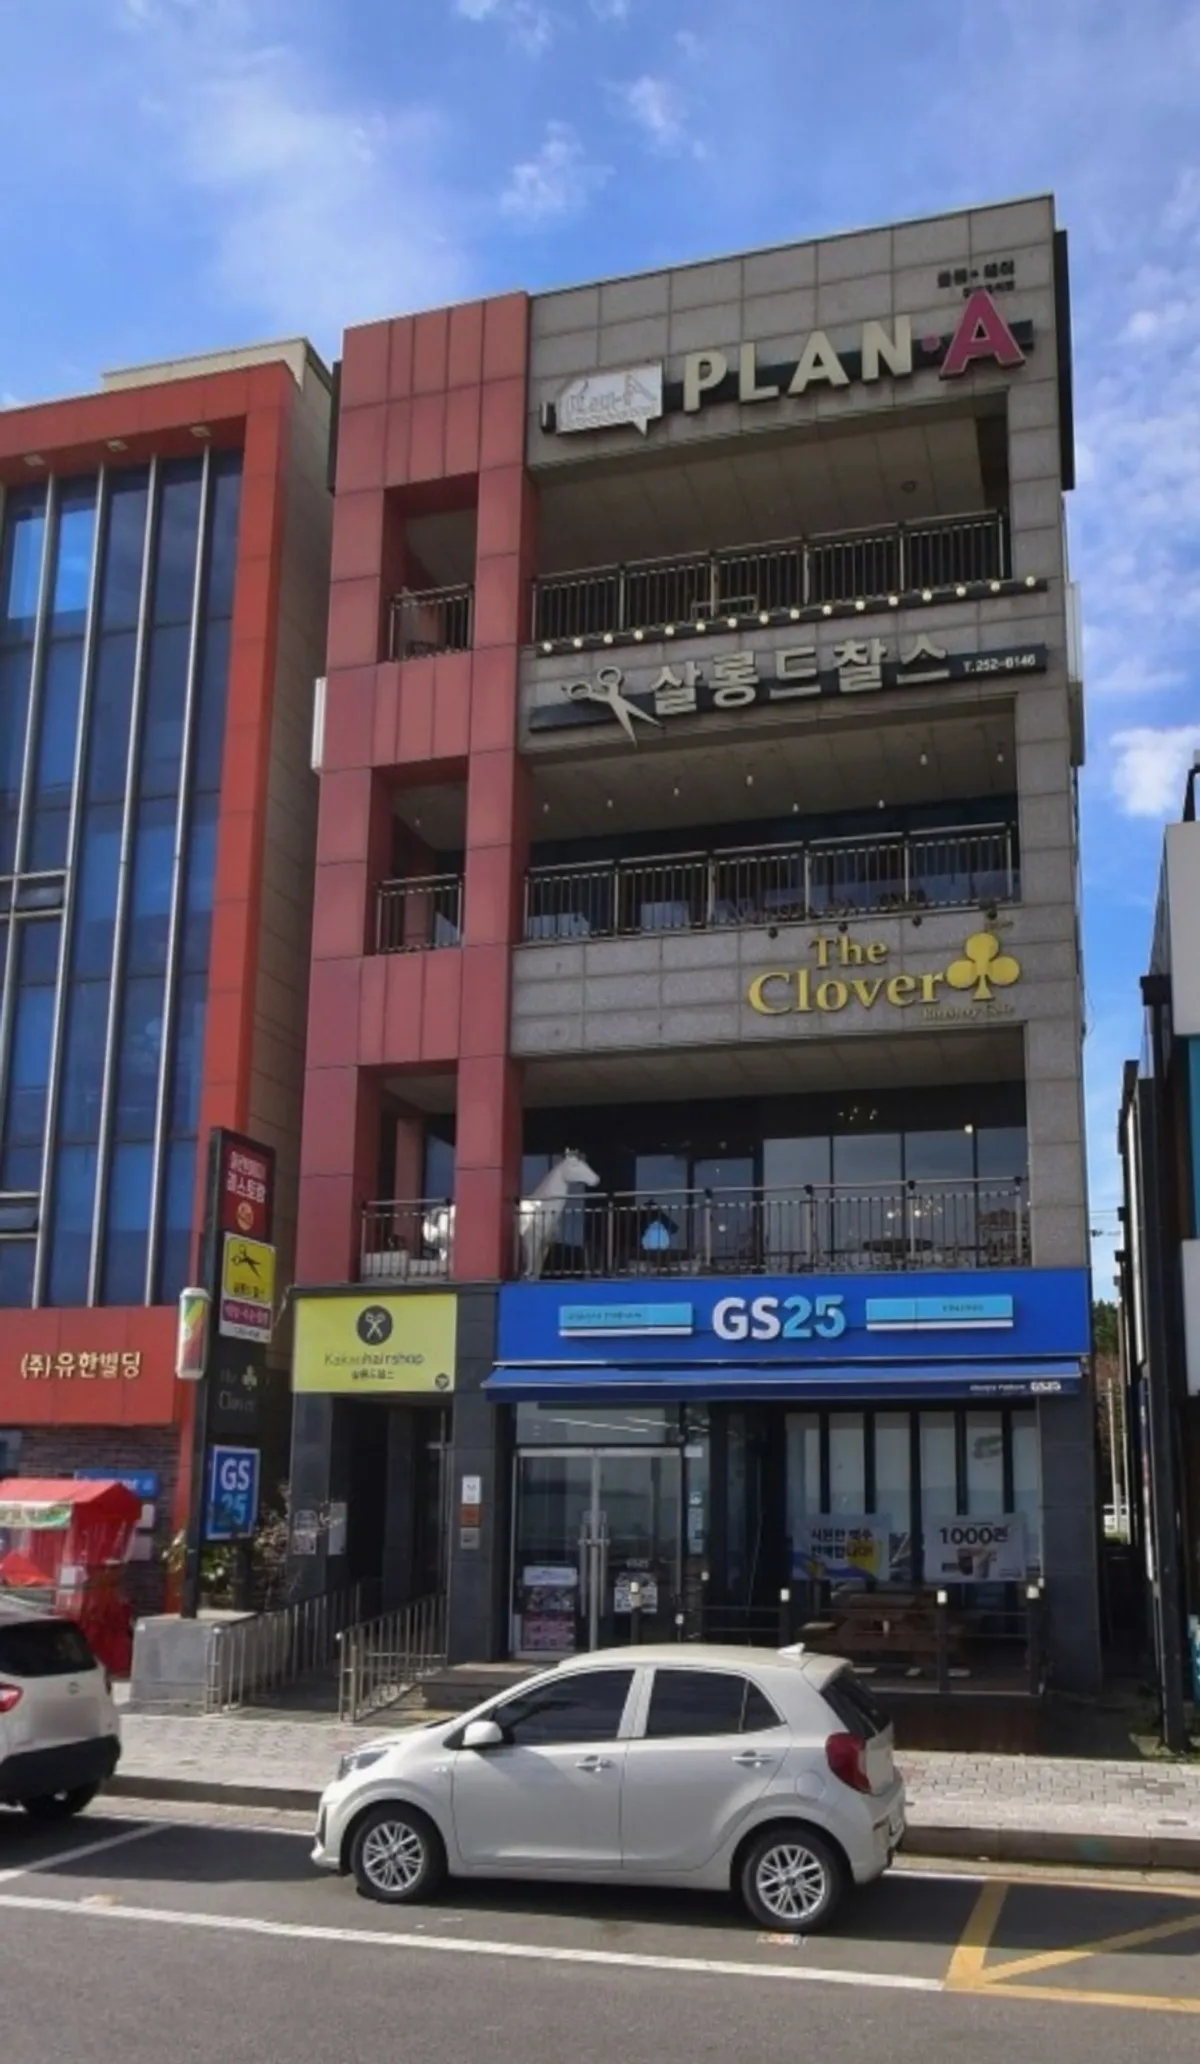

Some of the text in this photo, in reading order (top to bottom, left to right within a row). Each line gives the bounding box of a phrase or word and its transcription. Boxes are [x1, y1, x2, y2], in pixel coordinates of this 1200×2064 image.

[652, 634, 951, 716] 살롱드찰스
[809, 935, 889, 969] The
[748, 968, 945, 1016] Clover
[711, 1295, 846, 1341] GS25
[219, 1457, 251, 1491] GS
